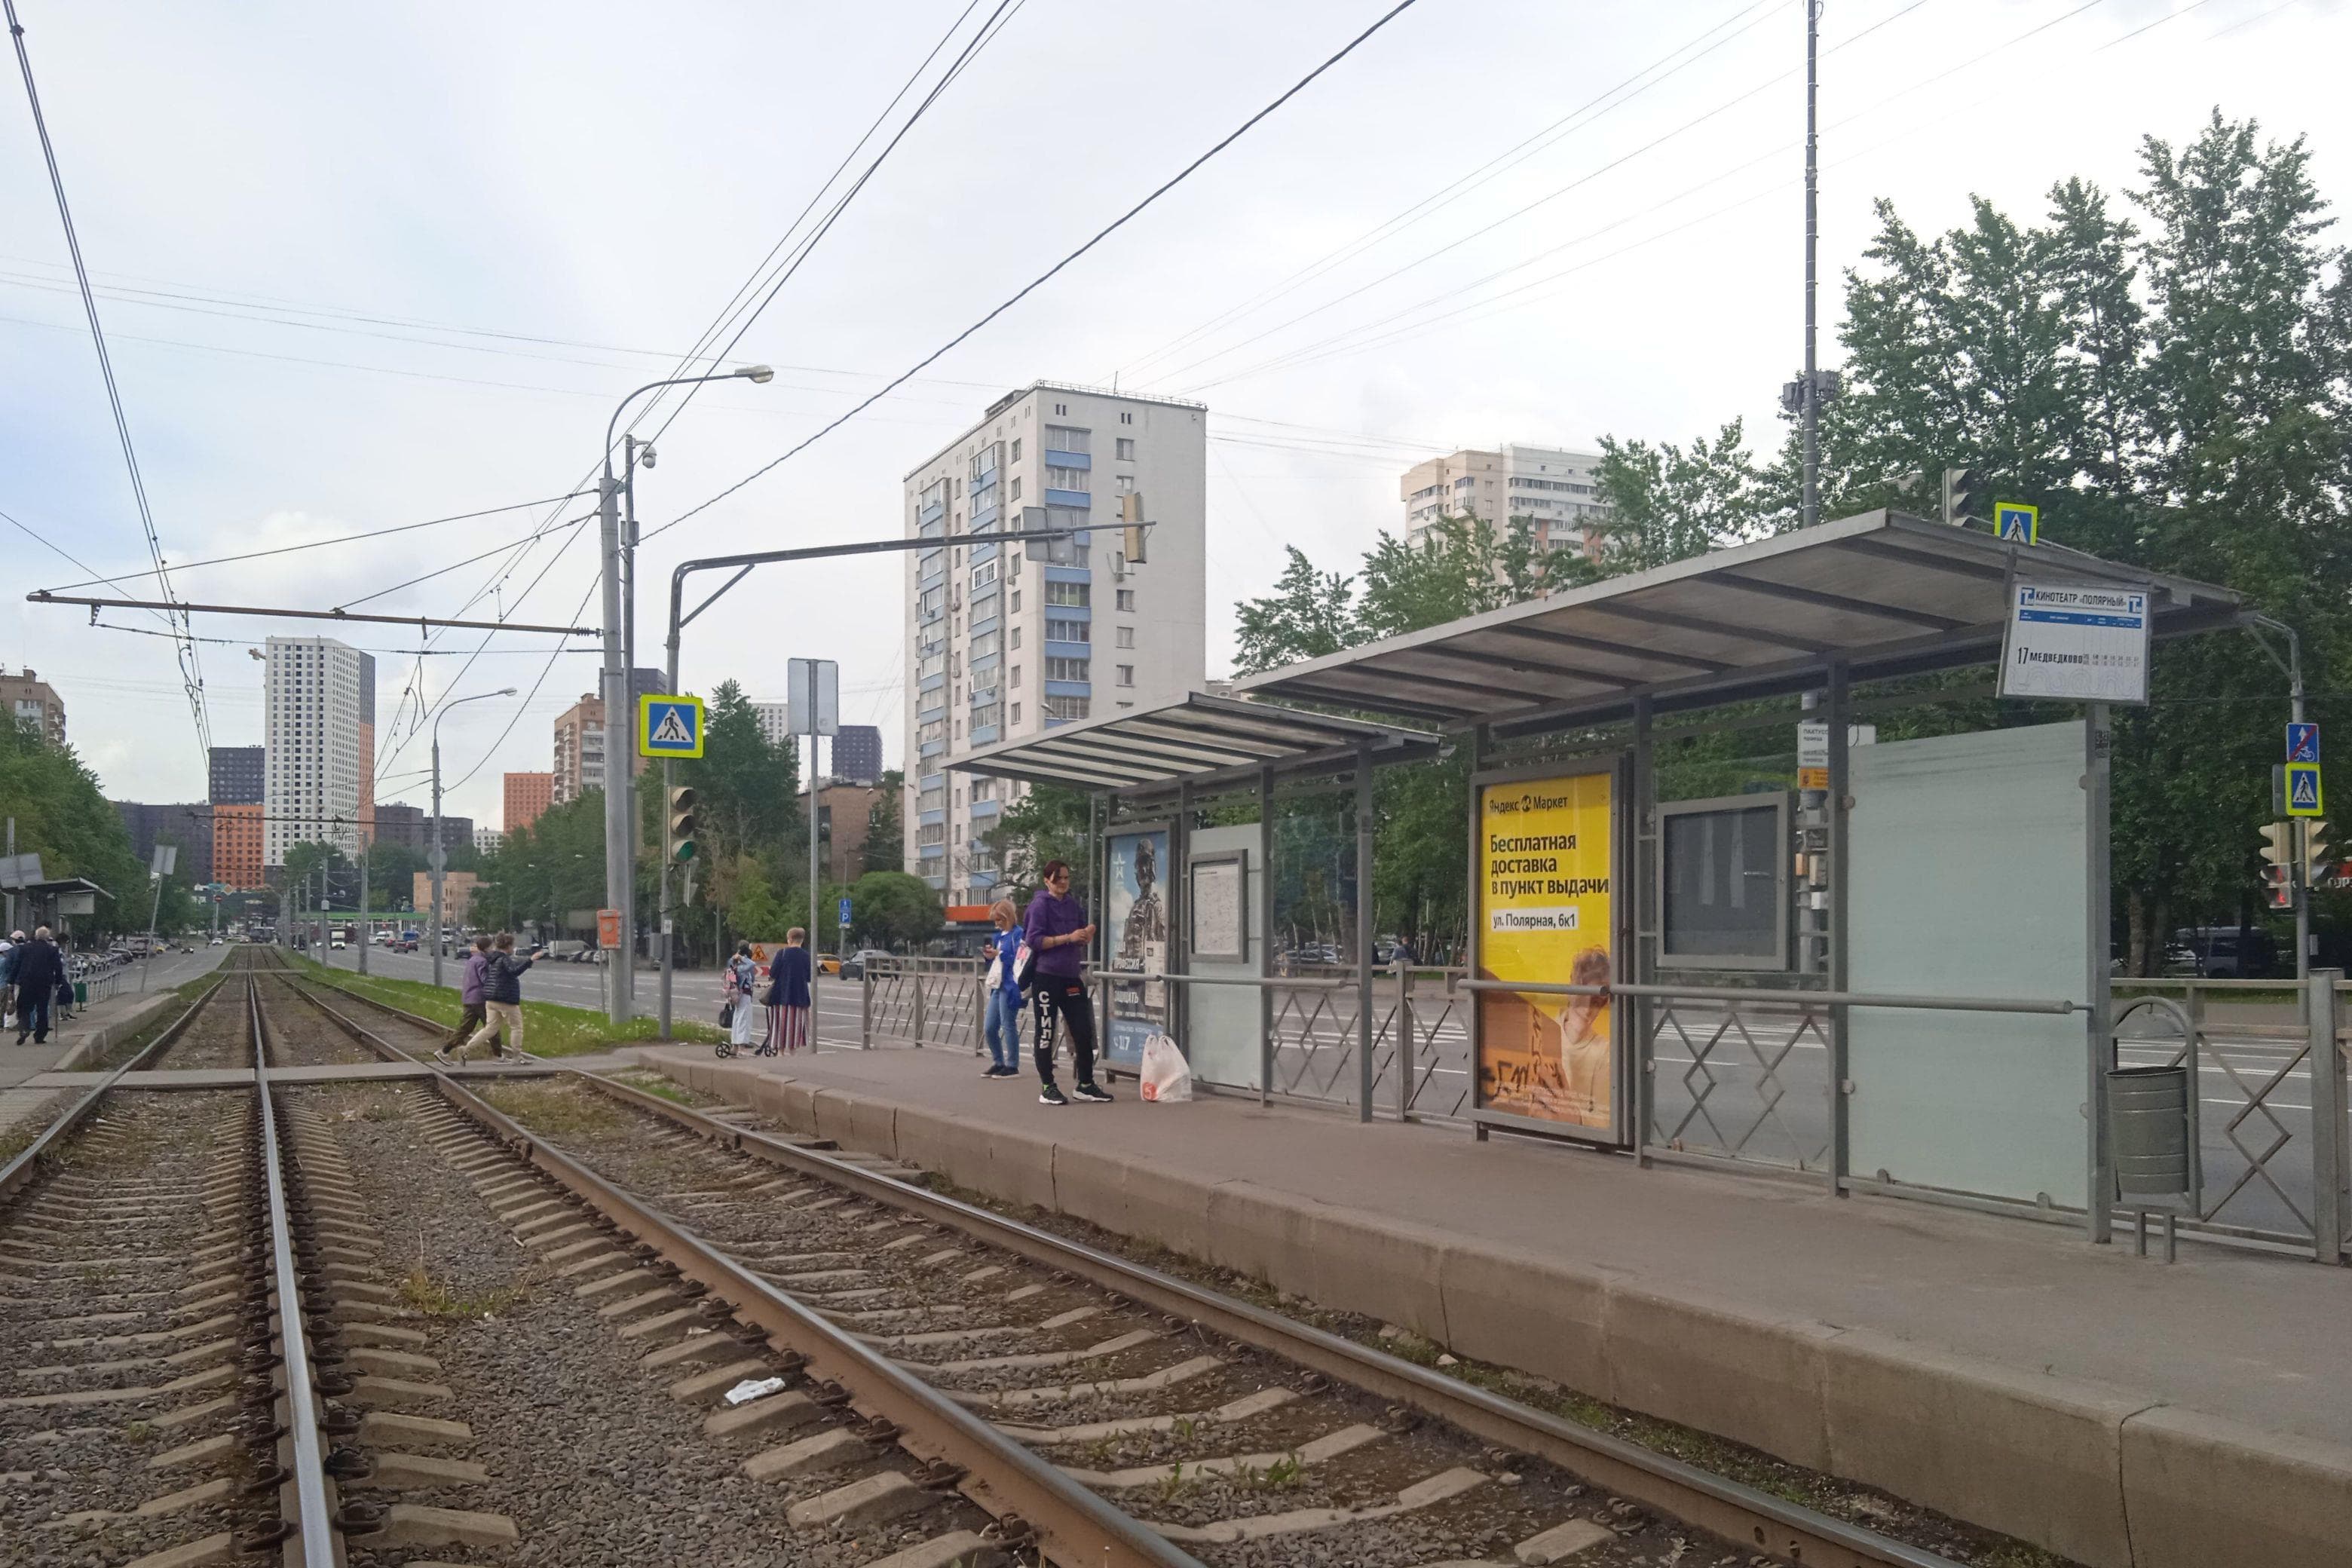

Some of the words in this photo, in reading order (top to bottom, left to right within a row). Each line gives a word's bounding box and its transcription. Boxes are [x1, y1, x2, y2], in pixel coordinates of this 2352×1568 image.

[2035, 591, 2078, 603] КИНОТЕАТР
[2018, 647, 2029, 664] 17
[2029, 652, 2083, 664] МЕДВЕДКОВО
[1490, 800, 1519, 814] Яндекс
[1533, 795, 1568, 813] Маркет
[1490, 835, 1576, 853] Бесплатная
[1491, 857, 1557, 877] доставка
[1492, 882, 1498, 895] в
[1500, 879, 1544, 899] пункт
[1548, 877, 1609, 899] выдачи
[842, 913, 849, 923] P
[1493, 915, 1504, 929] ул.
[1505, 913, 1556, 929] Полярная,
[1558, 914, 1576, 928] 6к1
